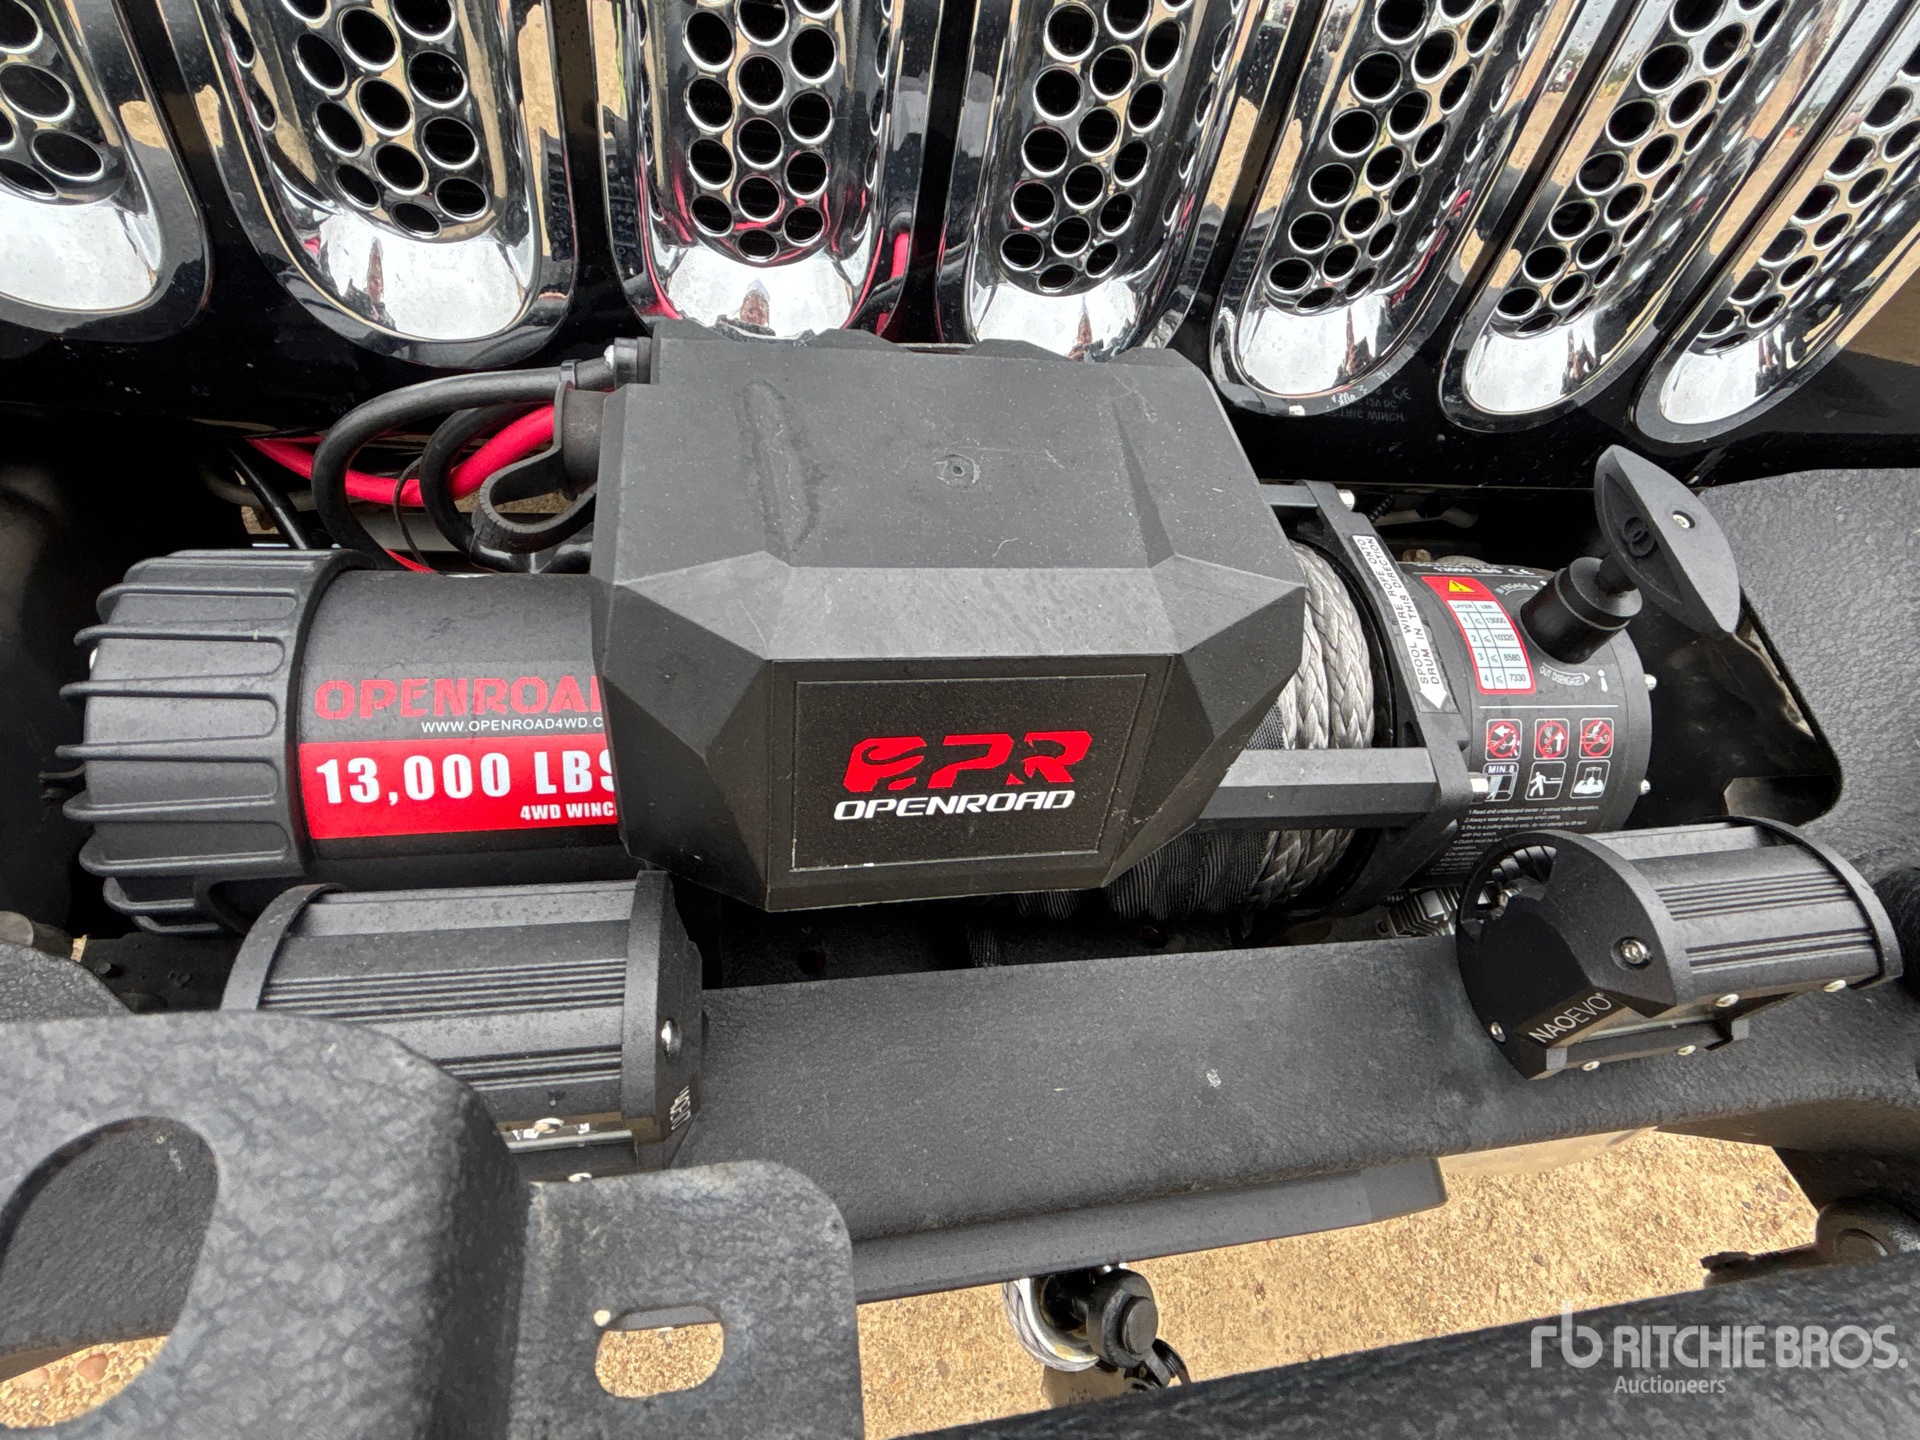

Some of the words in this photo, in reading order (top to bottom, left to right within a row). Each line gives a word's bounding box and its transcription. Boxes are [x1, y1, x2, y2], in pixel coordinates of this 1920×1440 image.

[1357, 538, 1377, 565] ONTO
[1368, 537, 1402, 589] DIRECTION
[1376, 570, 1398, 597] ROPE
[1394, 604, 1412, 634] WIRE
[1400, 595, 1417, 619] THIS
[1485, 616, 1507, 624] 13000
[1413, 627, 1425, 640] IN
[1471, 634, 1478, 642] 2
[1494, 633, 1516, 641] 10320
[1409, 641, 1429, 685] SPOOL
[1422, 649, 1440, 685] DRUM
[1477, 652, 1484, 660] 3
[1503, 653, 1521, 661] 8580
[1508, 673, 1526, 682] 7330
[314, 675, 602, 720] OPENROA
[421, 716, 604, 733] WWW.OPENROAD4WD.C
[315, 752, 511, 806] 13,000
[520, 803, 561, 820] 4WD
[565, 801, 617, 818] WINC
[833, 789, 1076, 821] OPENROAD
[1527, 994, 1613, 1044] NAOEVO
